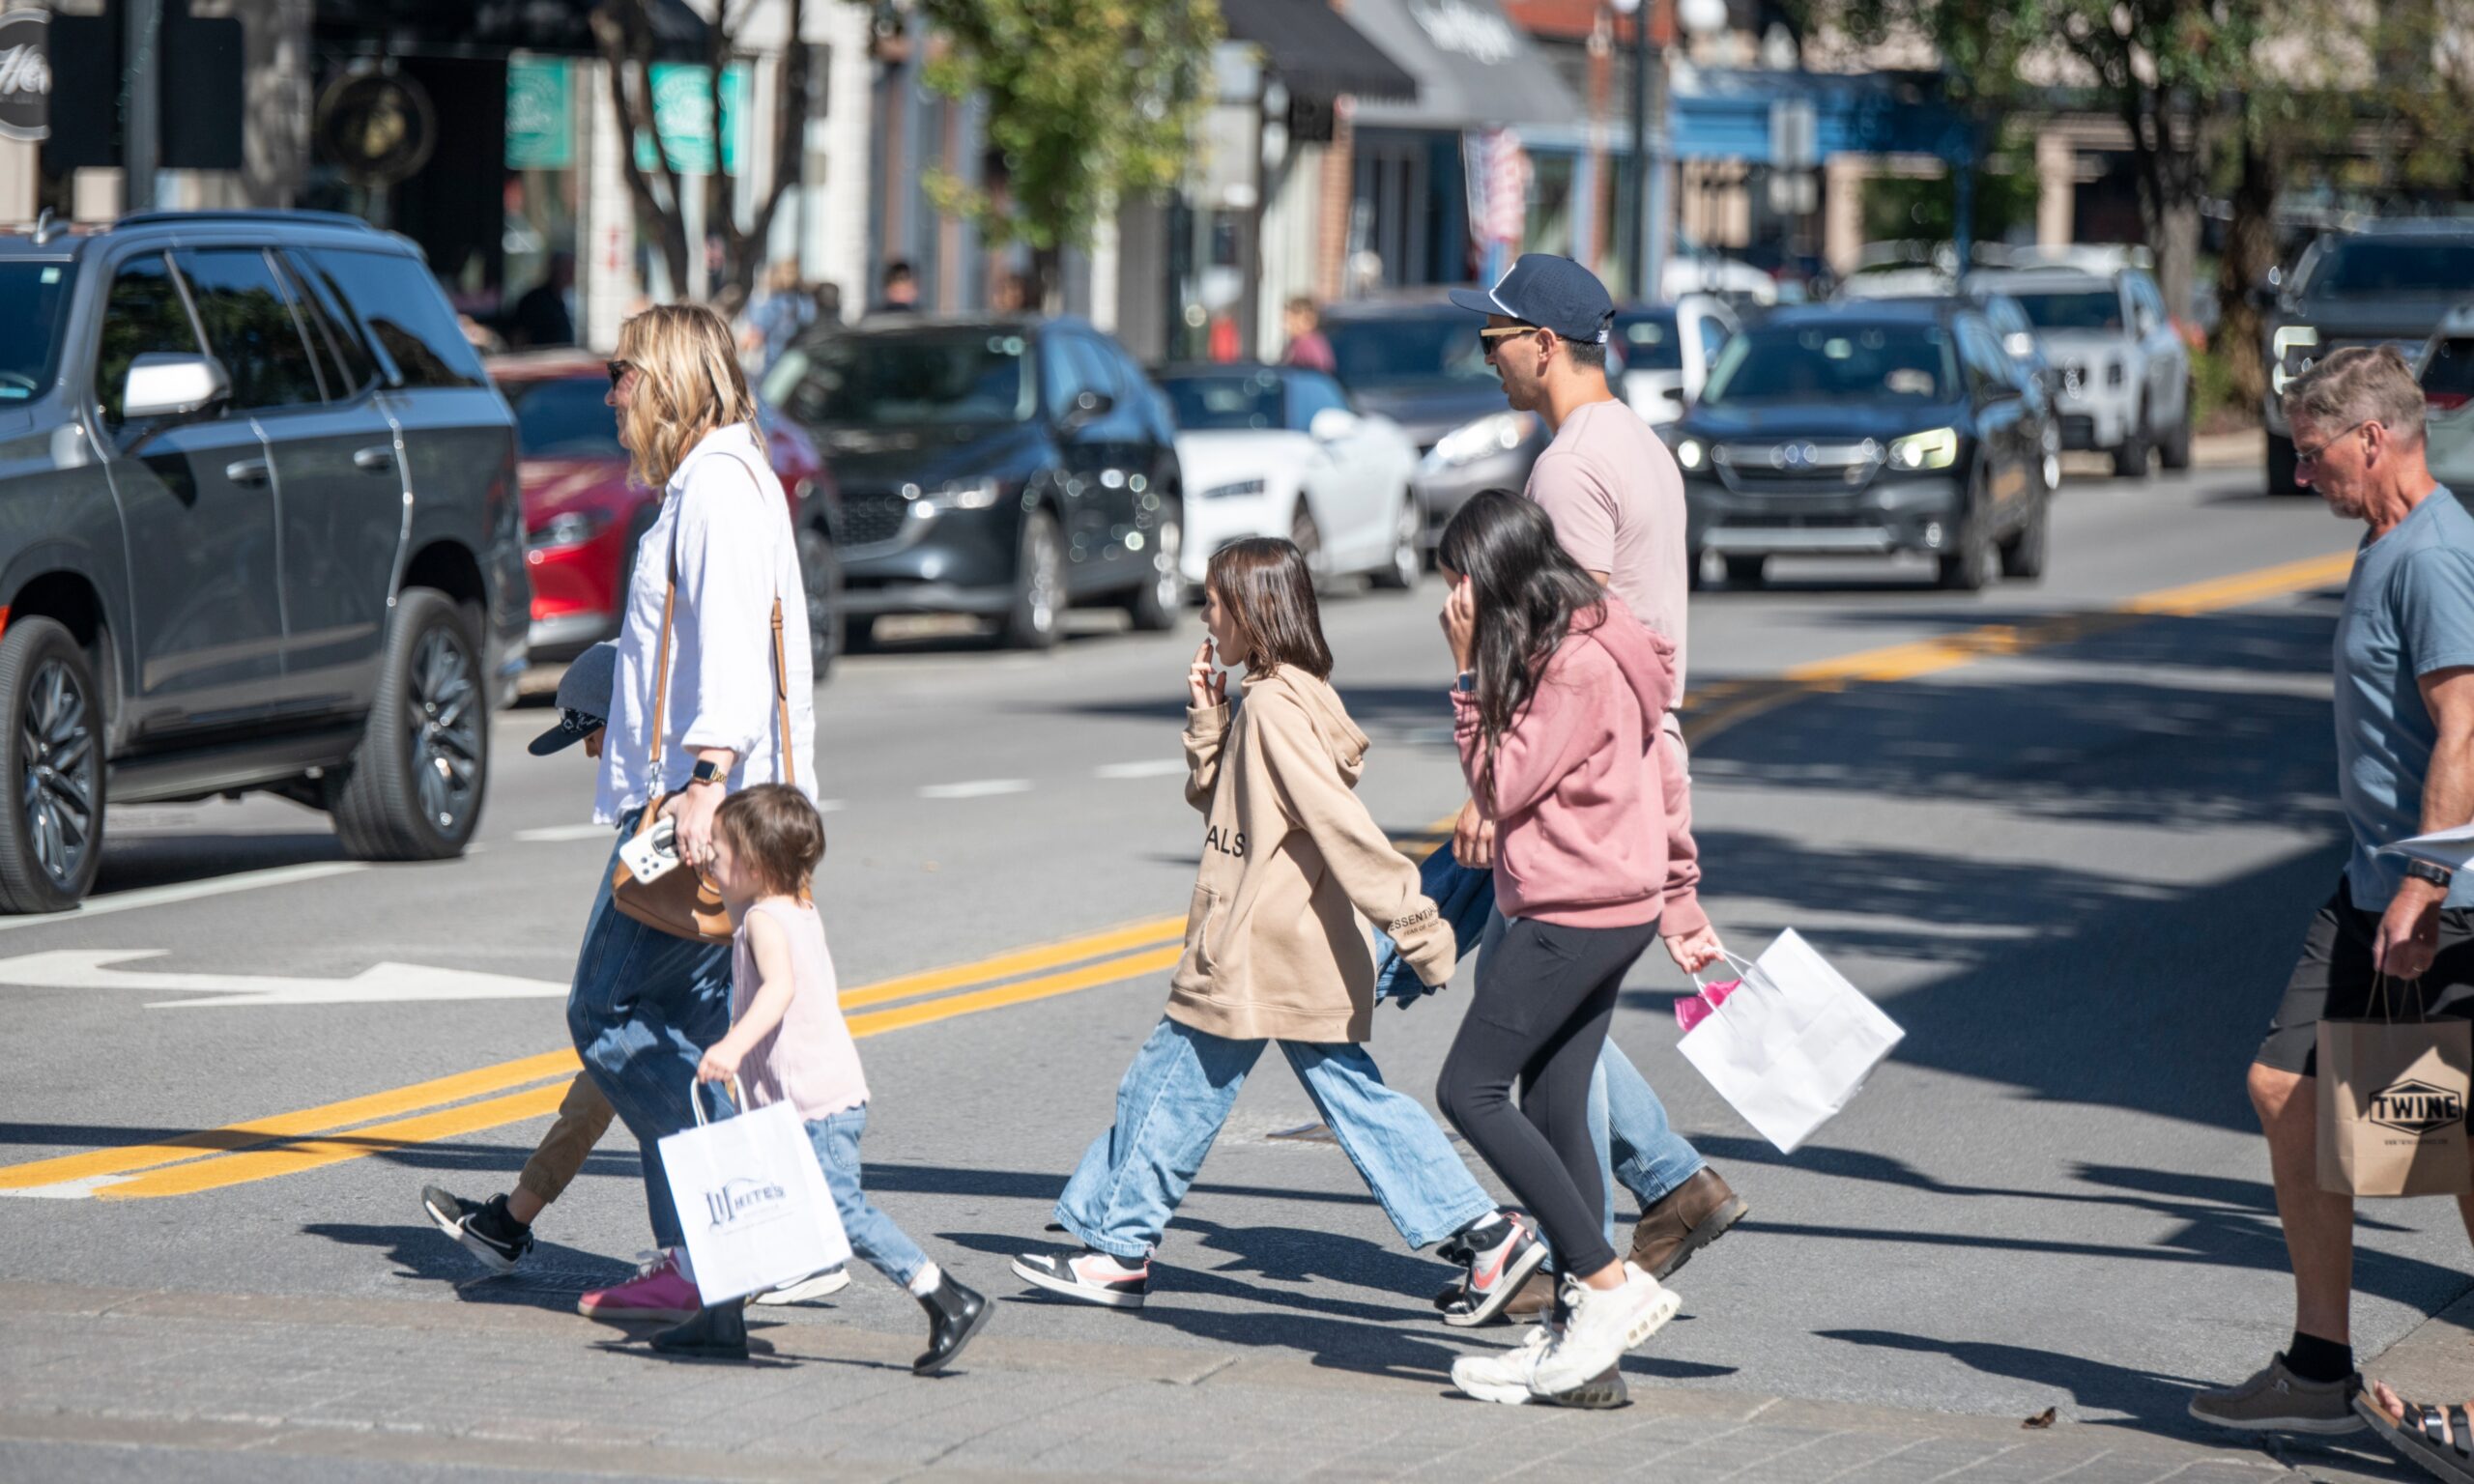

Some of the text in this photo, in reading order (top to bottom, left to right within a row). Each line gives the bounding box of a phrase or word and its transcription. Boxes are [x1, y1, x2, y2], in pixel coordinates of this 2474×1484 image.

[1403, 926, 1419, 937] FEAR
[1419, 924, 1426, 932] OF
[2373, 1096, 2458, 1119] TWINE
